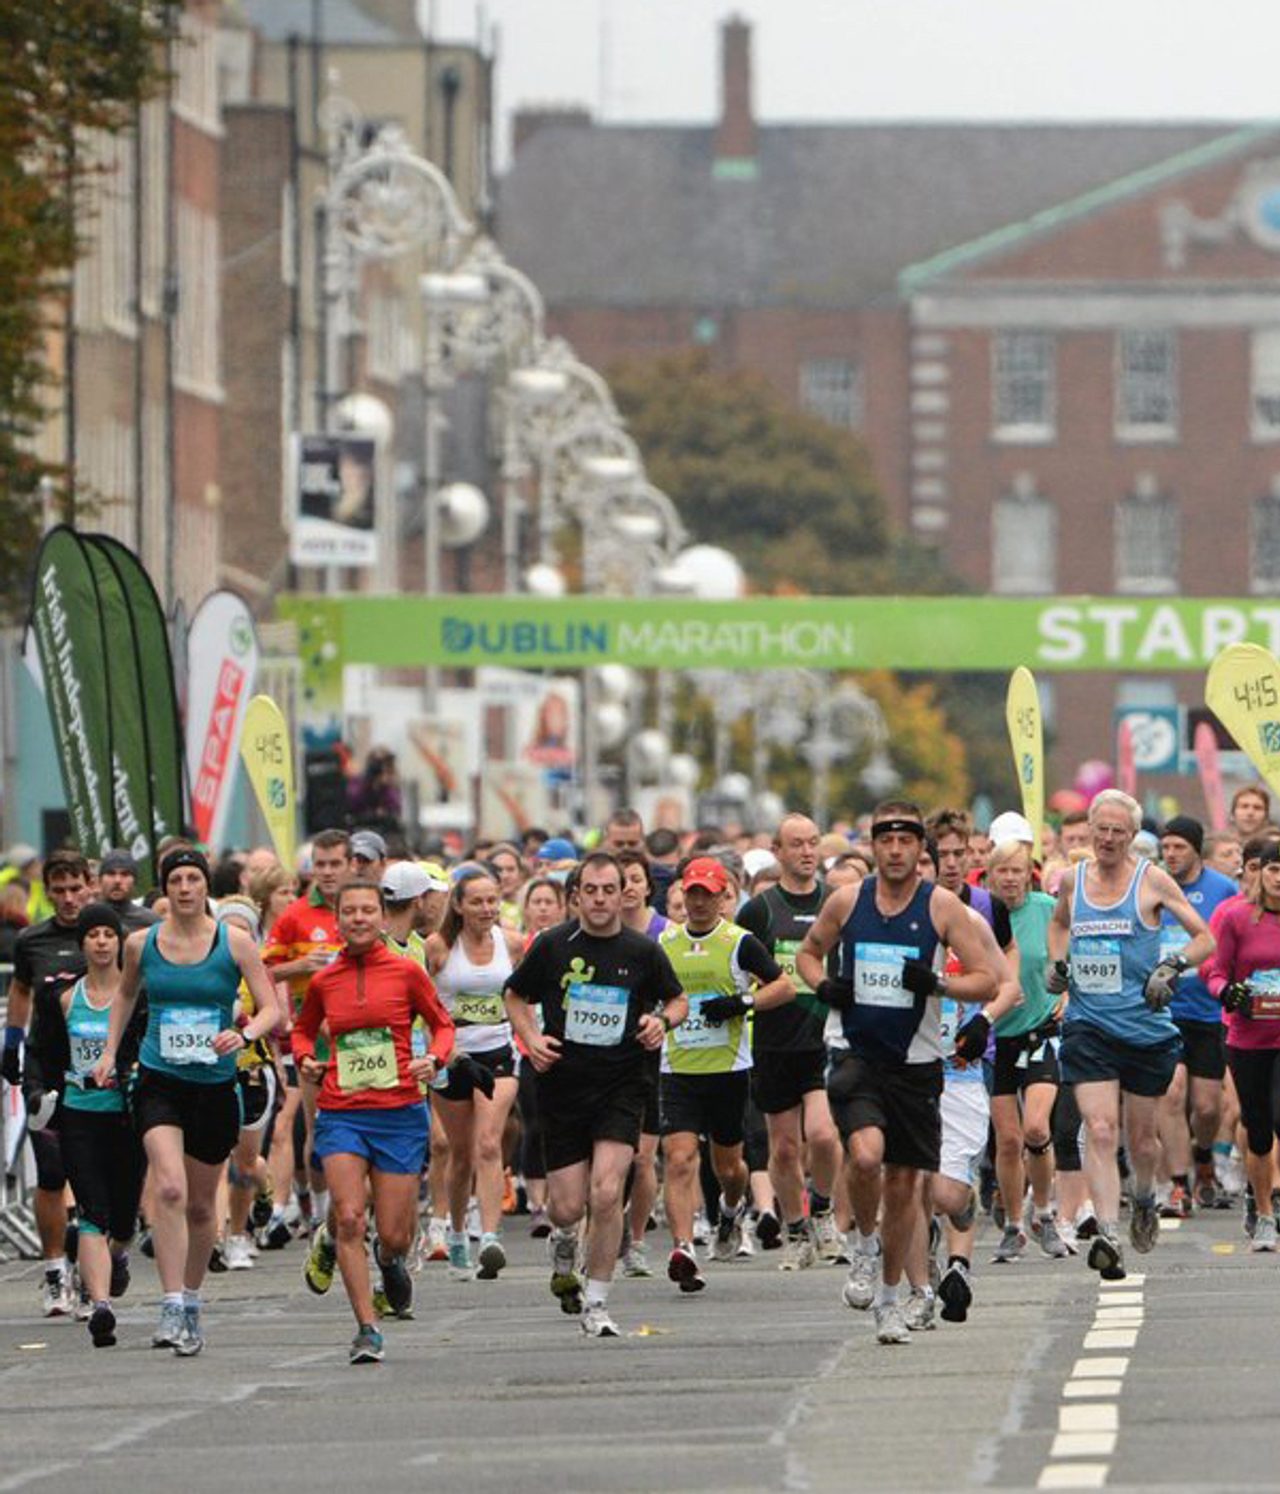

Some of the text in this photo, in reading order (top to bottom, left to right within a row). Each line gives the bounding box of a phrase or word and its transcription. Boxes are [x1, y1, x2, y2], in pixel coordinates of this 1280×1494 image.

[441, 617, 855, 657] DUBLIN MARATHON
[42, 563, 108, 845] Irish Independent
[1233, 674, 1279, 711] 4:15
[193, 662, 246, 807] SPAR
[862, 971, 902, 988] 1586
[1076, 963, 1117, 977] 14987
[573, 1010, 621, 1026] 17909
[347, 1055, 388, 1073] 7266
